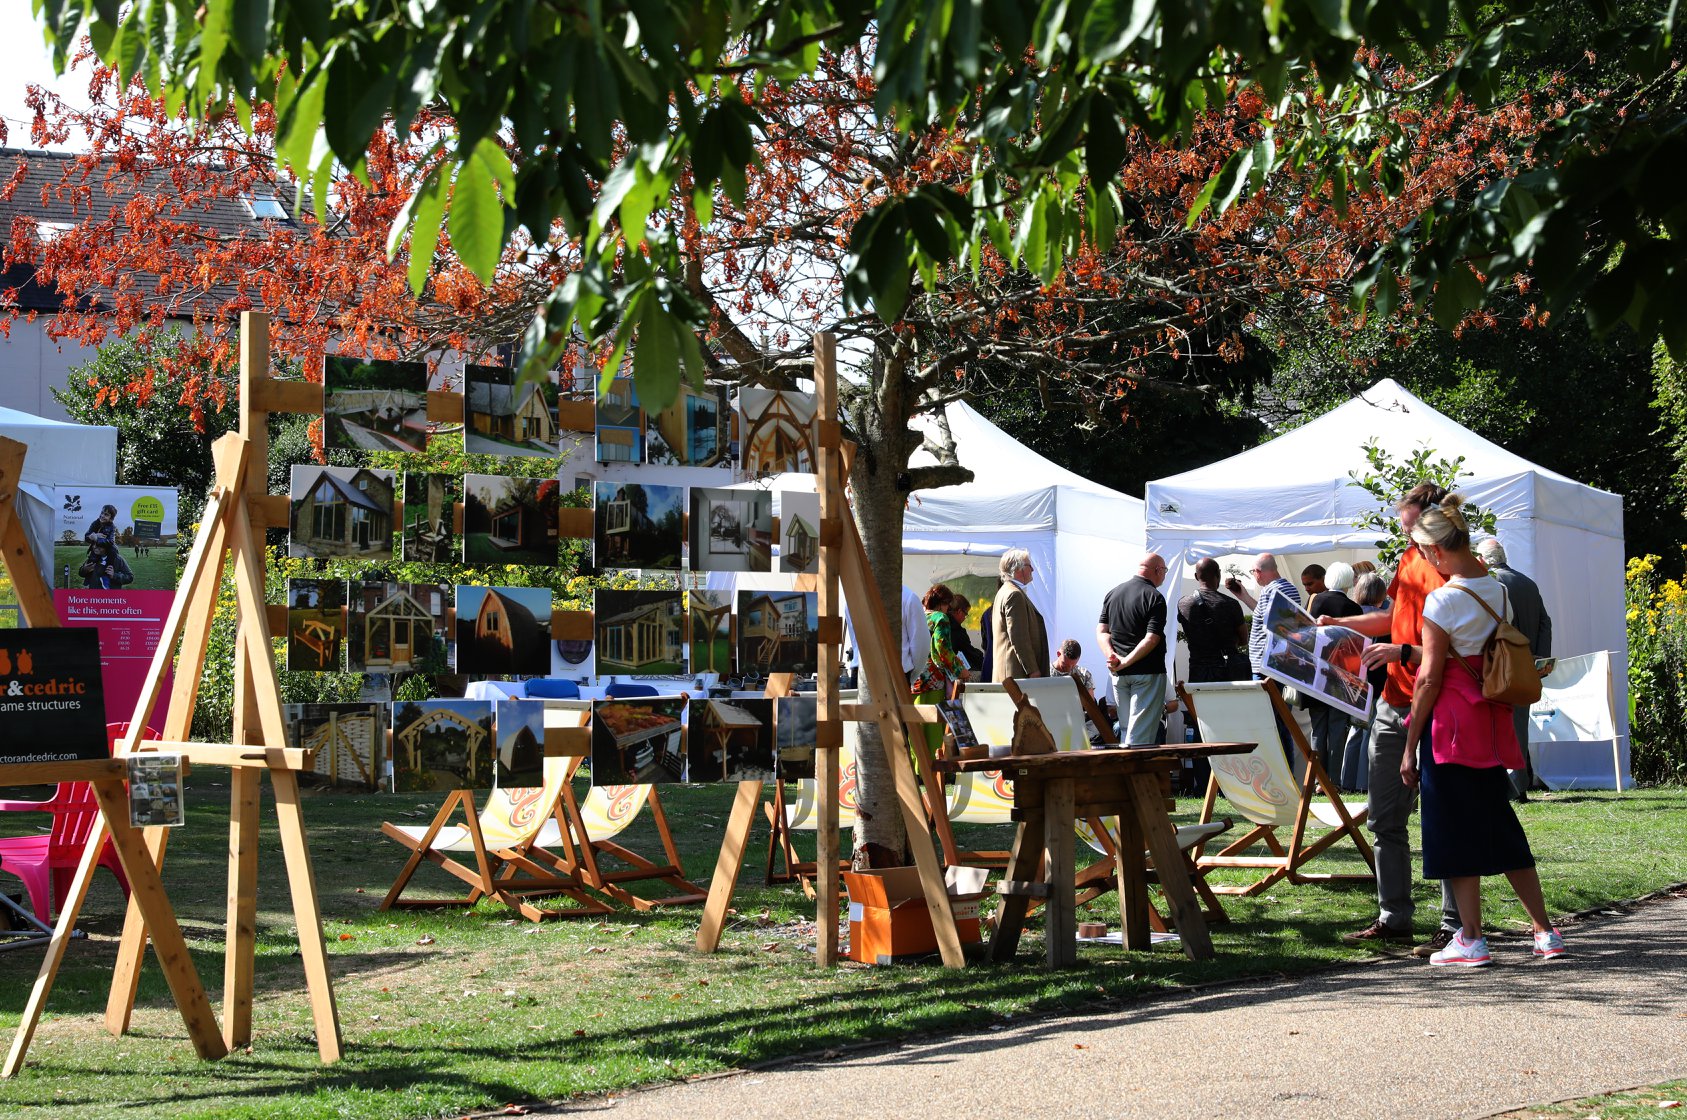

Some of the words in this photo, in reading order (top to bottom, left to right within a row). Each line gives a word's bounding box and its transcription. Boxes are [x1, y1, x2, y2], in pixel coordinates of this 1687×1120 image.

[68, 606, 81, 614] like
[83, 607, 99, 615] this,
[27, 700, 81, 710] structures
